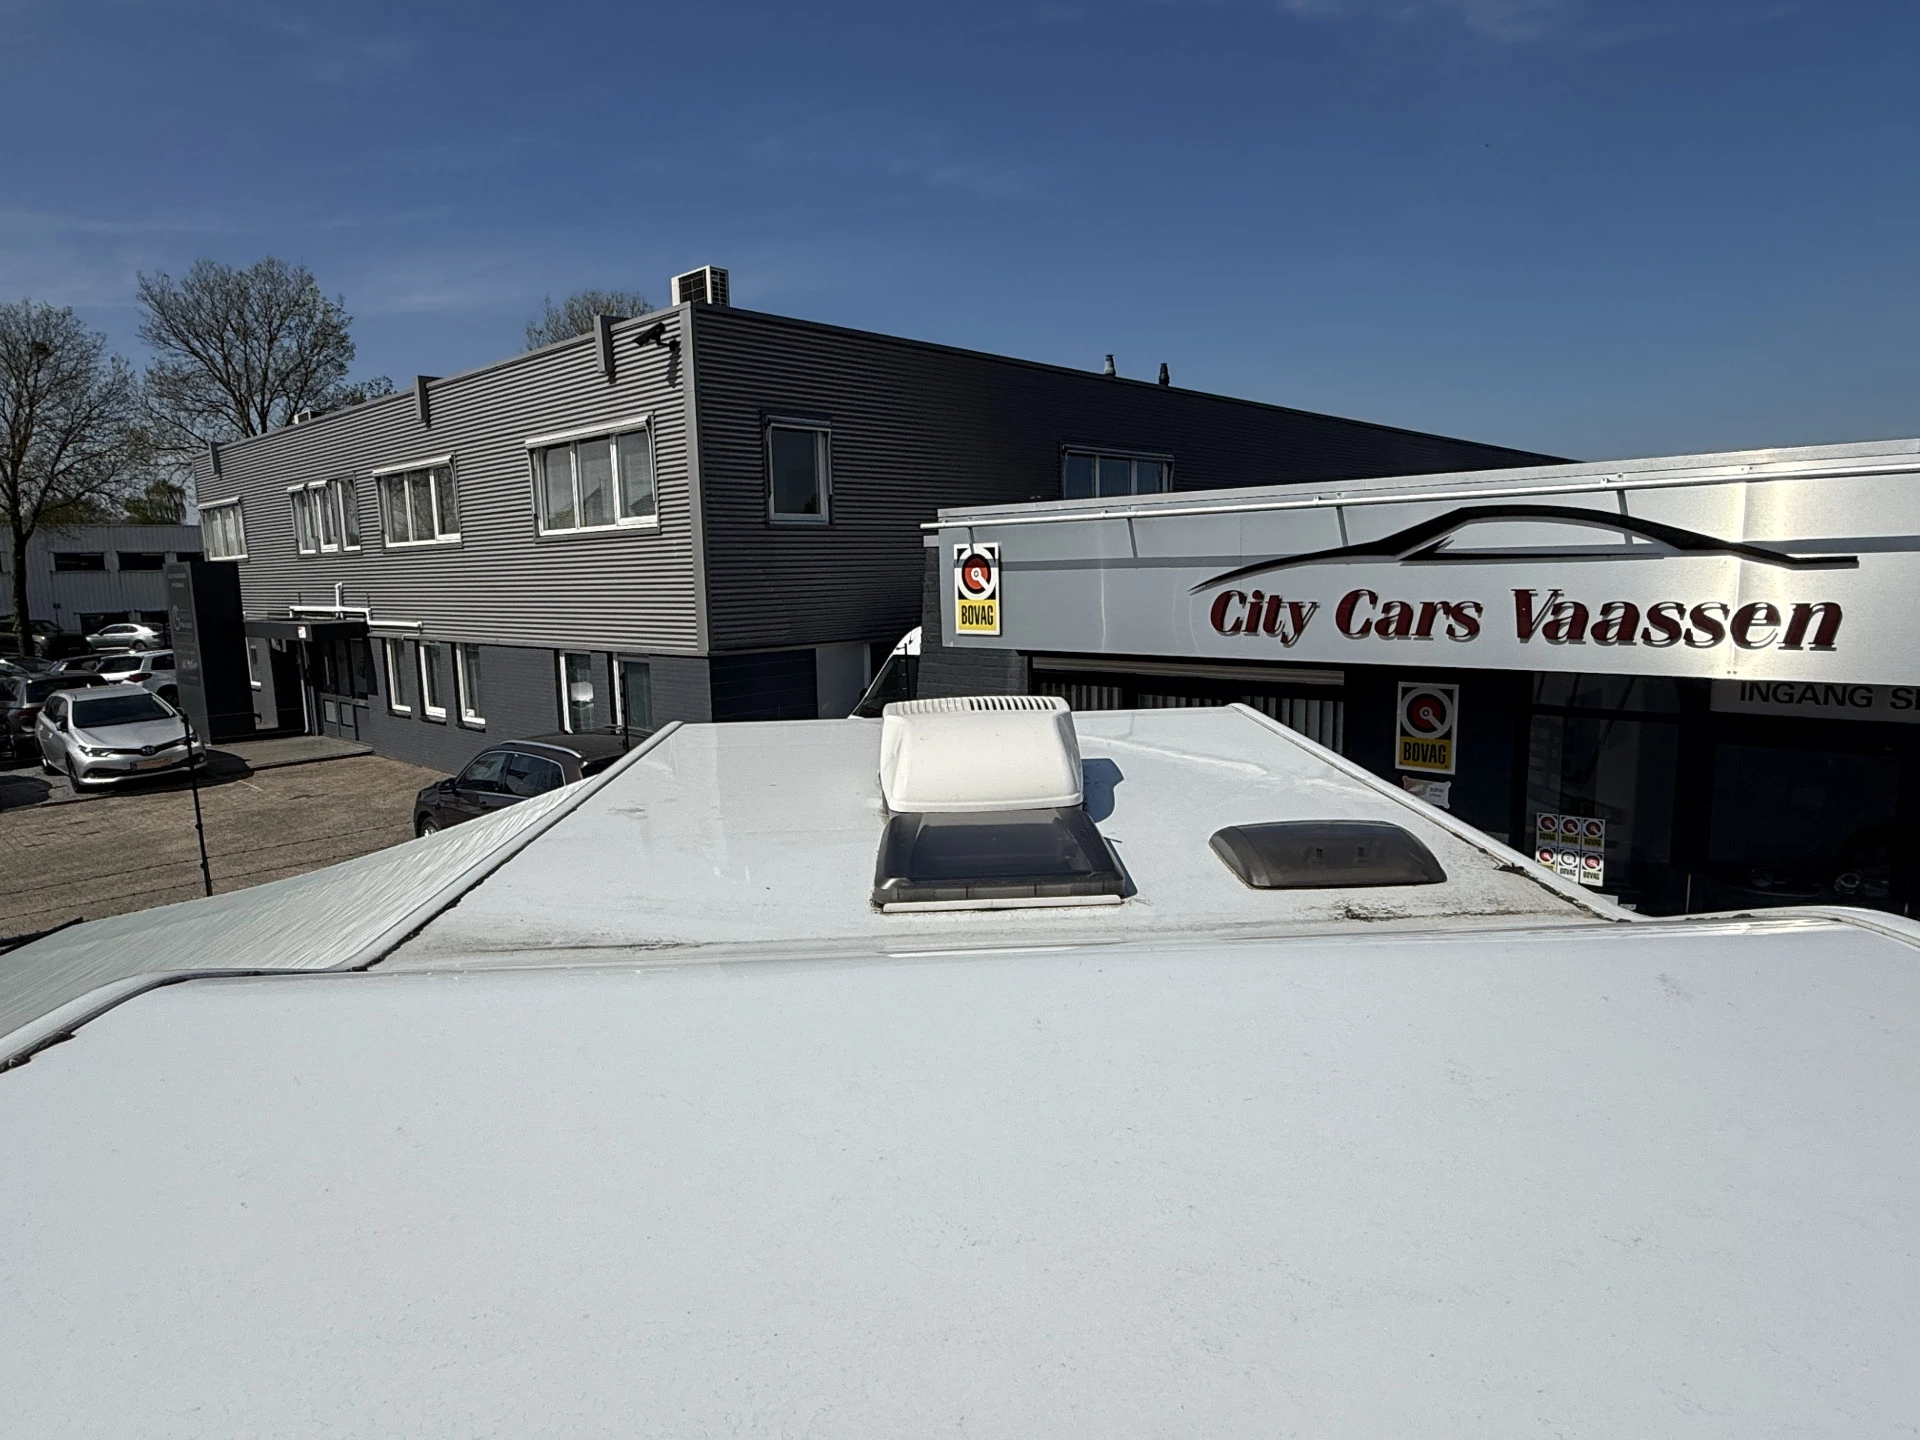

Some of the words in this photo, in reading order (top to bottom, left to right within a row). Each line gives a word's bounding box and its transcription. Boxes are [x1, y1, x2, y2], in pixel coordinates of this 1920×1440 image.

[961, 604, 994, 626] BOVAG
[1210, 589, 1319, 647] City
[1335, 589, 1483, 642] Cars
[1511, 589, 1844, 650] Vaassen
[1739, 681, 1873, 708] INGANG
[1889, 687, 1920, 711] S
[1403, 741, 1447, 765] BOVAG
[1559, 867, 1577, 876] BOVAG
[1583, 871, 1600, 880] BOVAG
